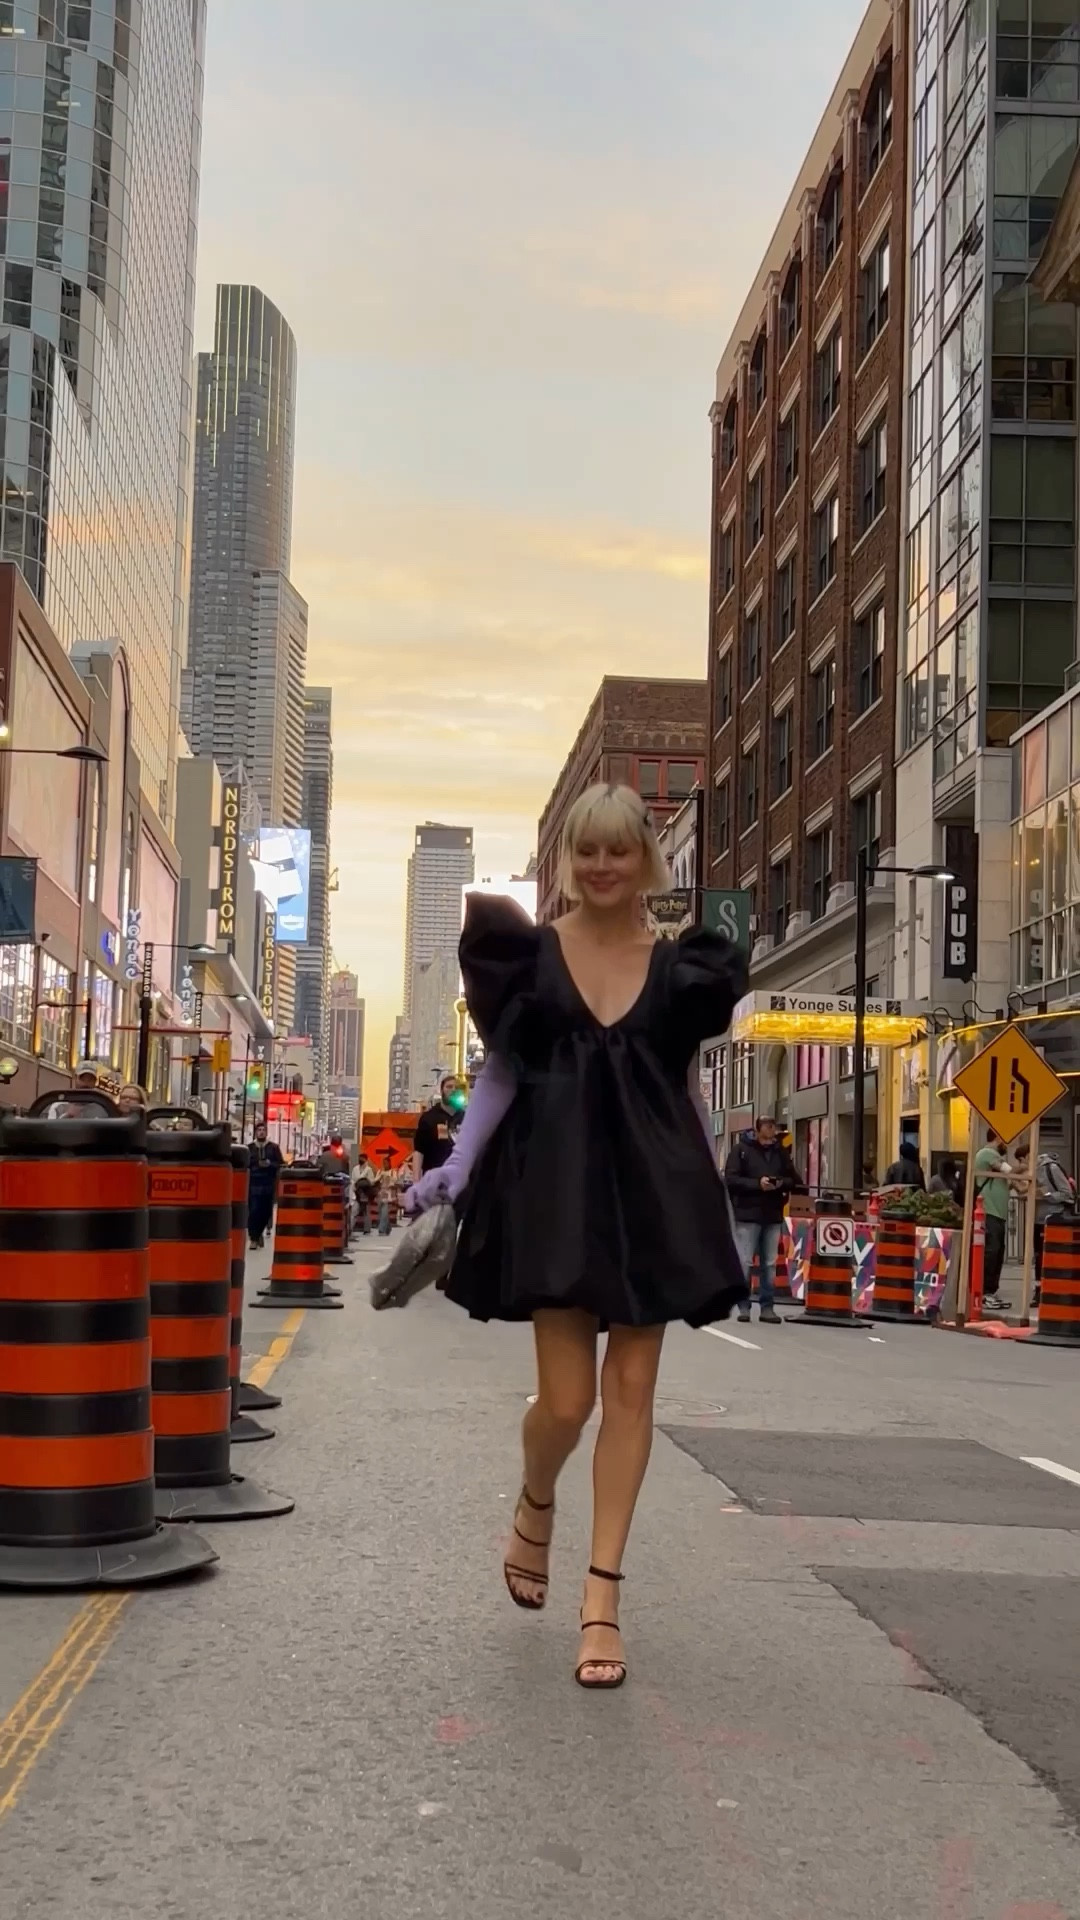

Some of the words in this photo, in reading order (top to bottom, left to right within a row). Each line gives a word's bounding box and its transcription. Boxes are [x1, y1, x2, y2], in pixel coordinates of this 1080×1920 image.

[219, 787, 238, 934] NORDSTROM
[262, 914, 276, 1018] NORDSTROM
[950, 886, 967, 965] PUB
[789, 998, 834, 1013] Yonge
[838, 1000, 883, 1013] Sues
